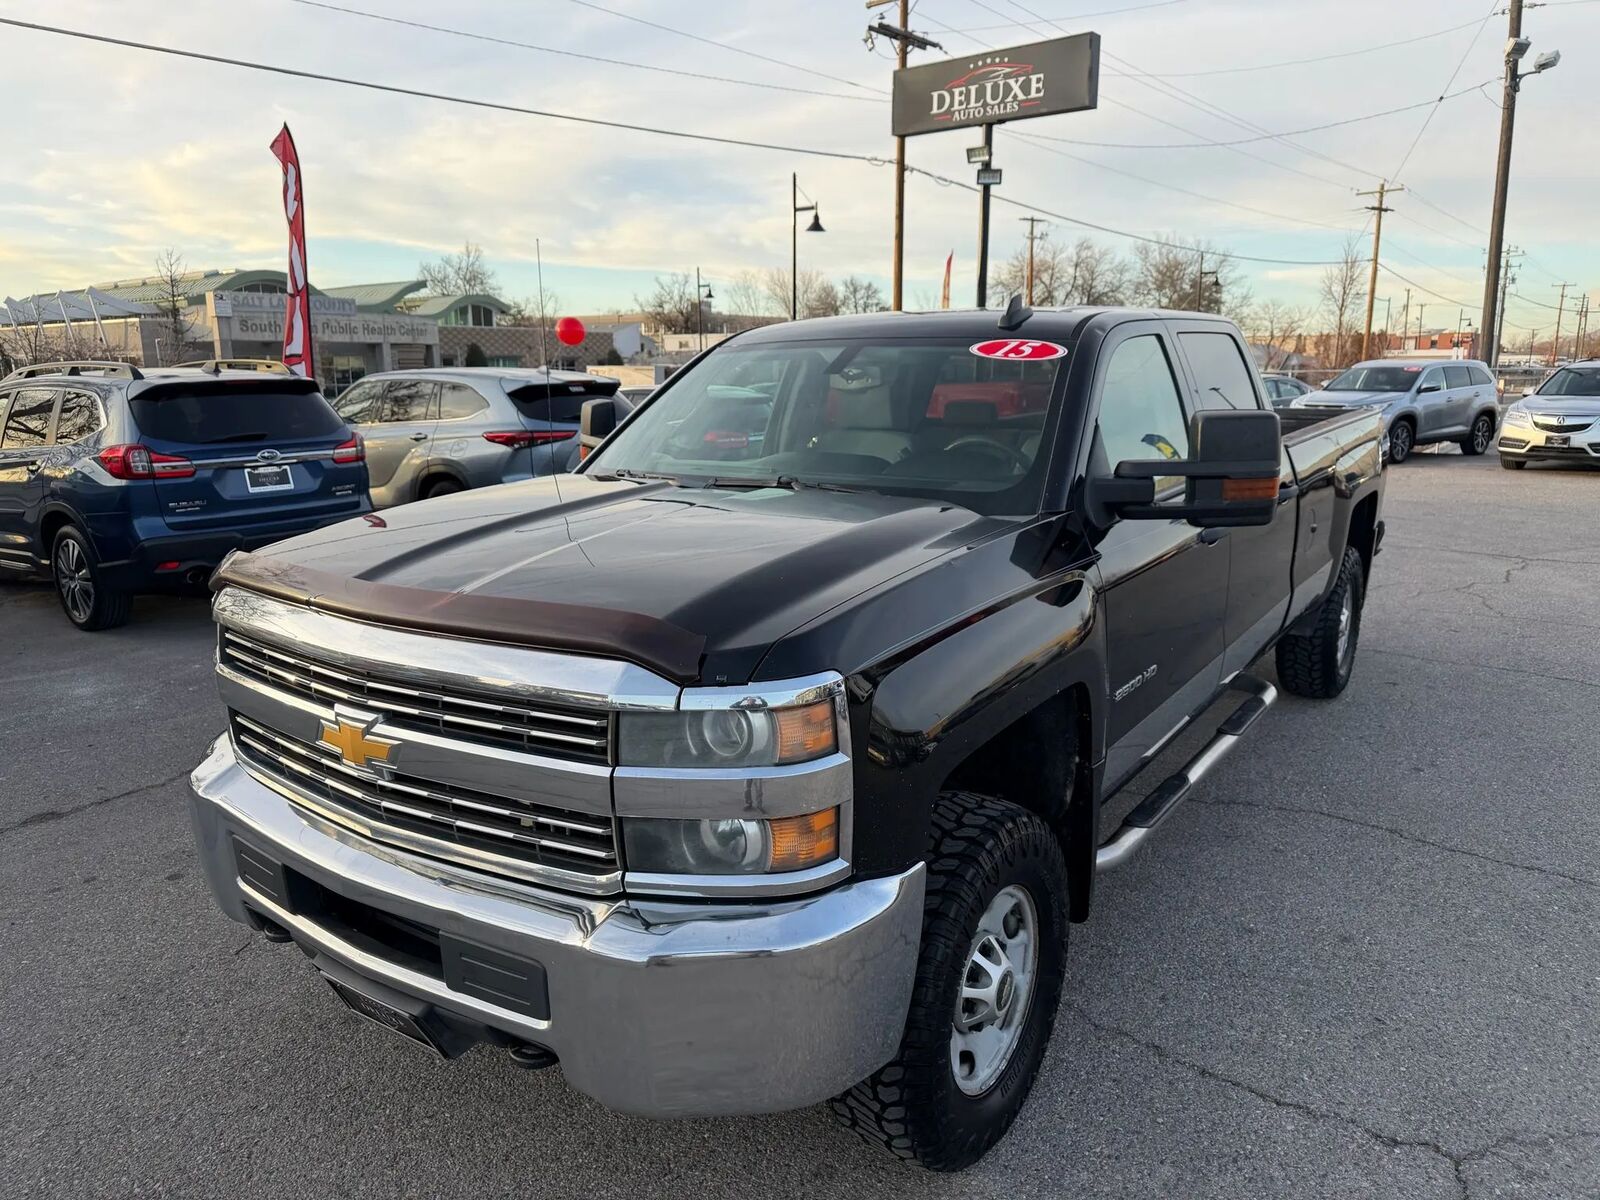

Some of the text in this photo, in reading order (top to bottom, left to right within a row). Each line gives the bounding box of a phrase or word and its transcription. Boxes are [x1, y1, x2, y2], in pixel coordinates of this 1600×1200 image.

[930, 73, 1045, 114] DELUXE
[952, 101, 1019, 121] AUTO SALES
[233, 295, 264, 308] SALT
[309, 298, 354, 312] OUNTY
[240, 319, 282, 333] South
[322, 321, 359, 335] Public
[362, 323, 397, 336] Health
[399, 324, 428, 337] Center
[990, 341, 1042, 358] 15
